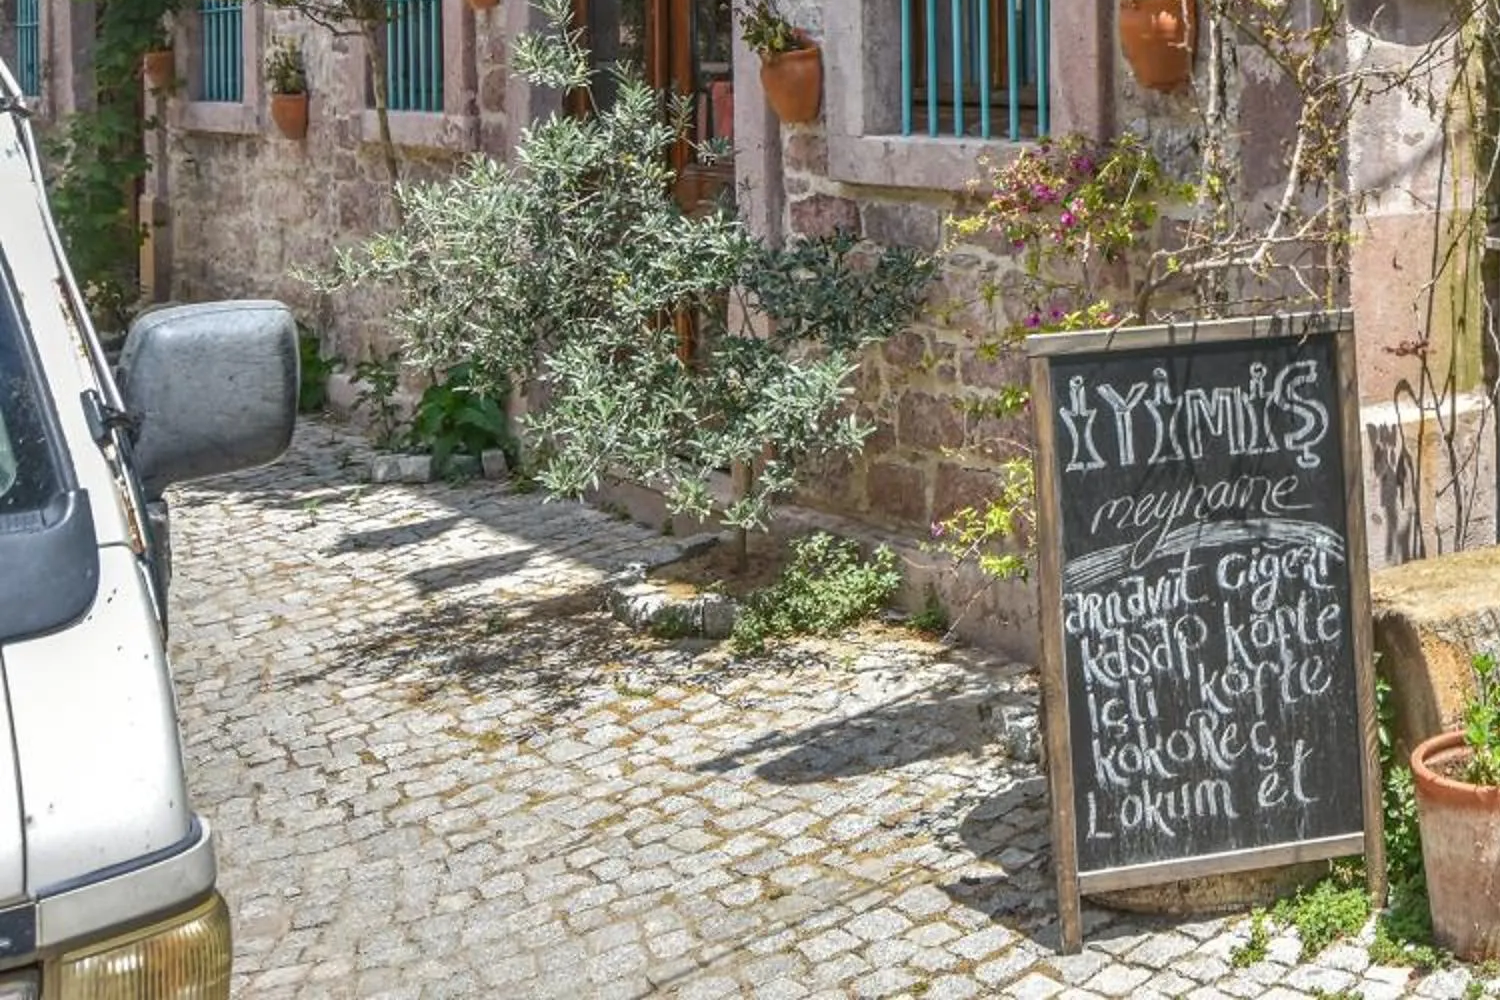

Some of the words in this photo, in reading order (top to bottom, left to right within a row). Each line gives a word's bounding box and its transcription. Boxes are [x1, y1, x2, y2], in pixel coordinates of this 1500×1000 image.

[1091, 475, 1313, 569] meyhane
[1198, 654, 1332, 715] köfte
[1257, 739, 1318, 807] et
